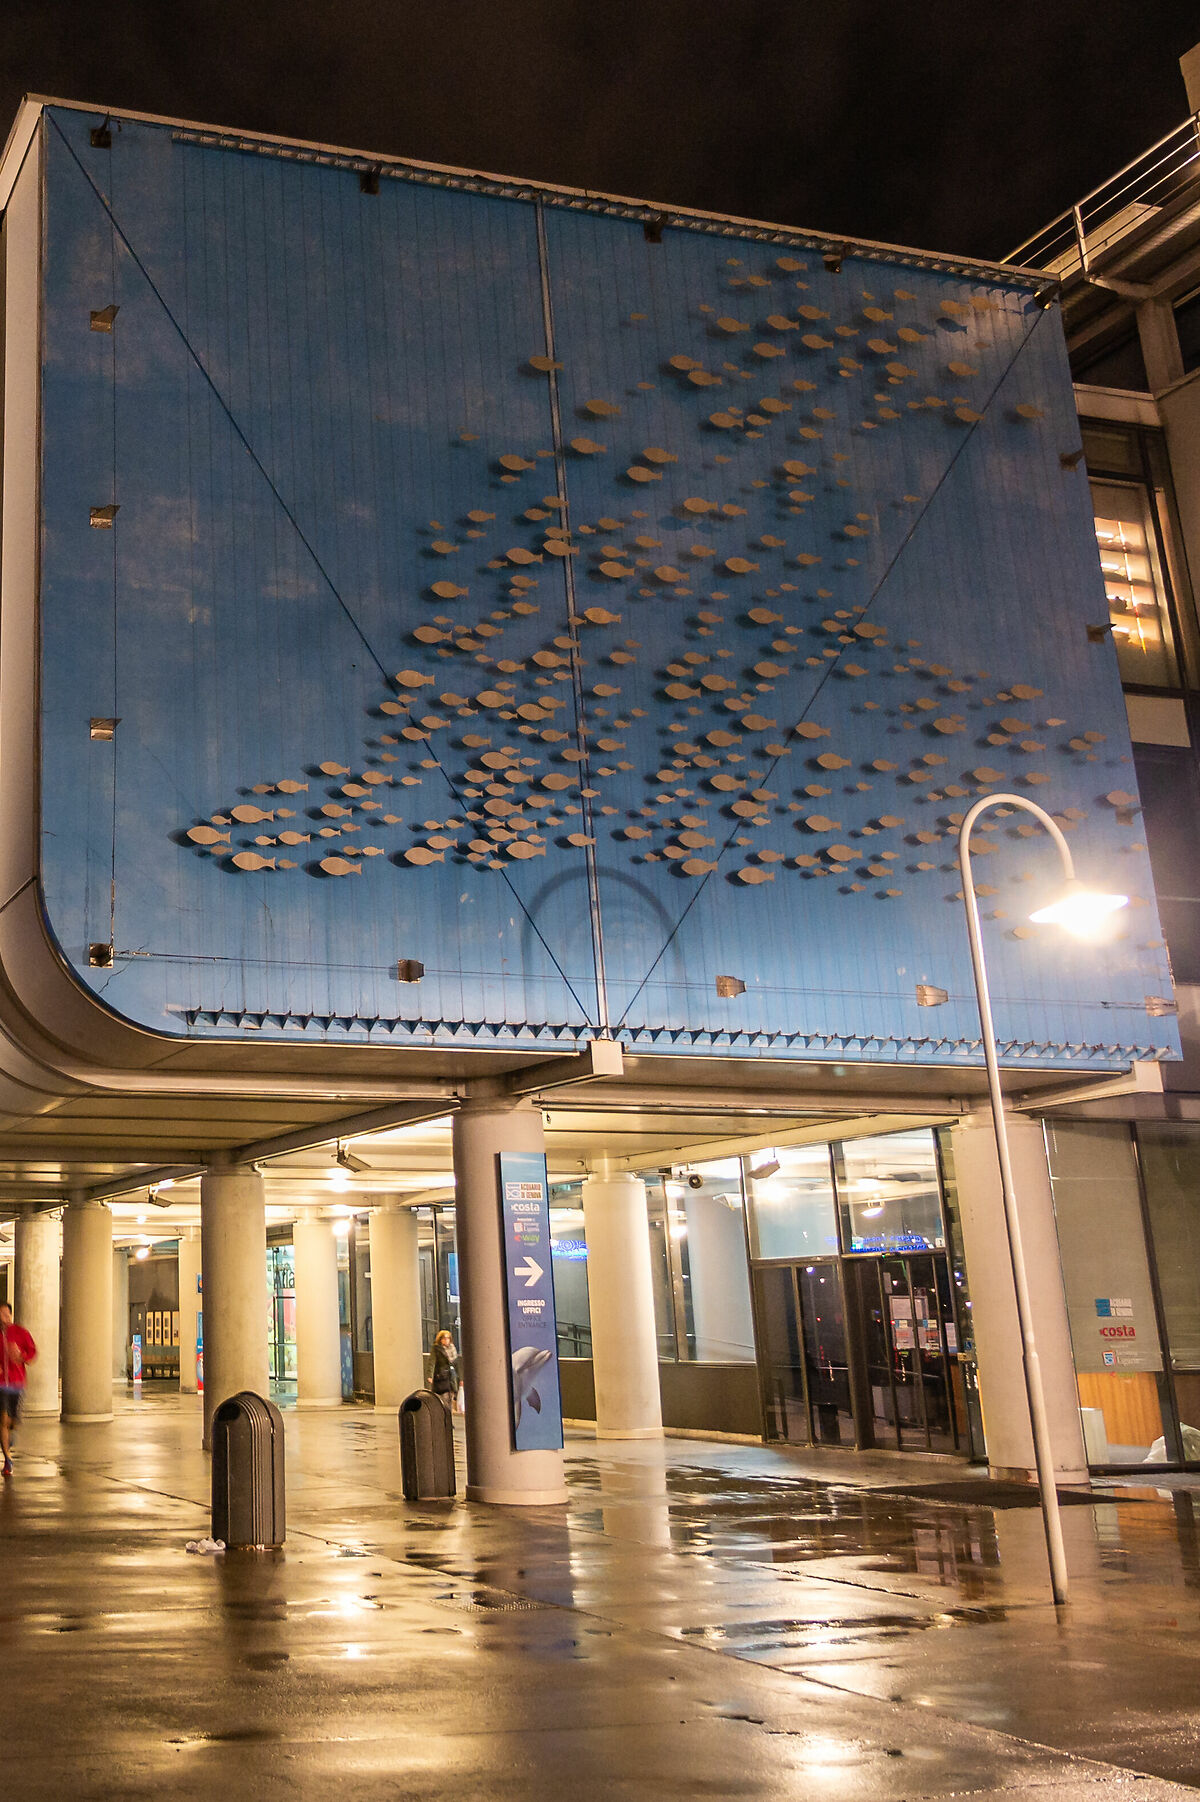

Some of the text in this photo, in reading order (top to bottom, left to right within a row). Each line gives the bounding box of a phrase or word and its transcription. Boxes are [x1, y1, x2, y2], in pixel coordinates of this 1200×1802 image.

[513, 1202, 540, 1211] costa
[517, 1299, 546, 1307] INGRESSO
[522, 1306, 541, 1314] UFFICI
[1102, 1325, 1136, 1337] costa
